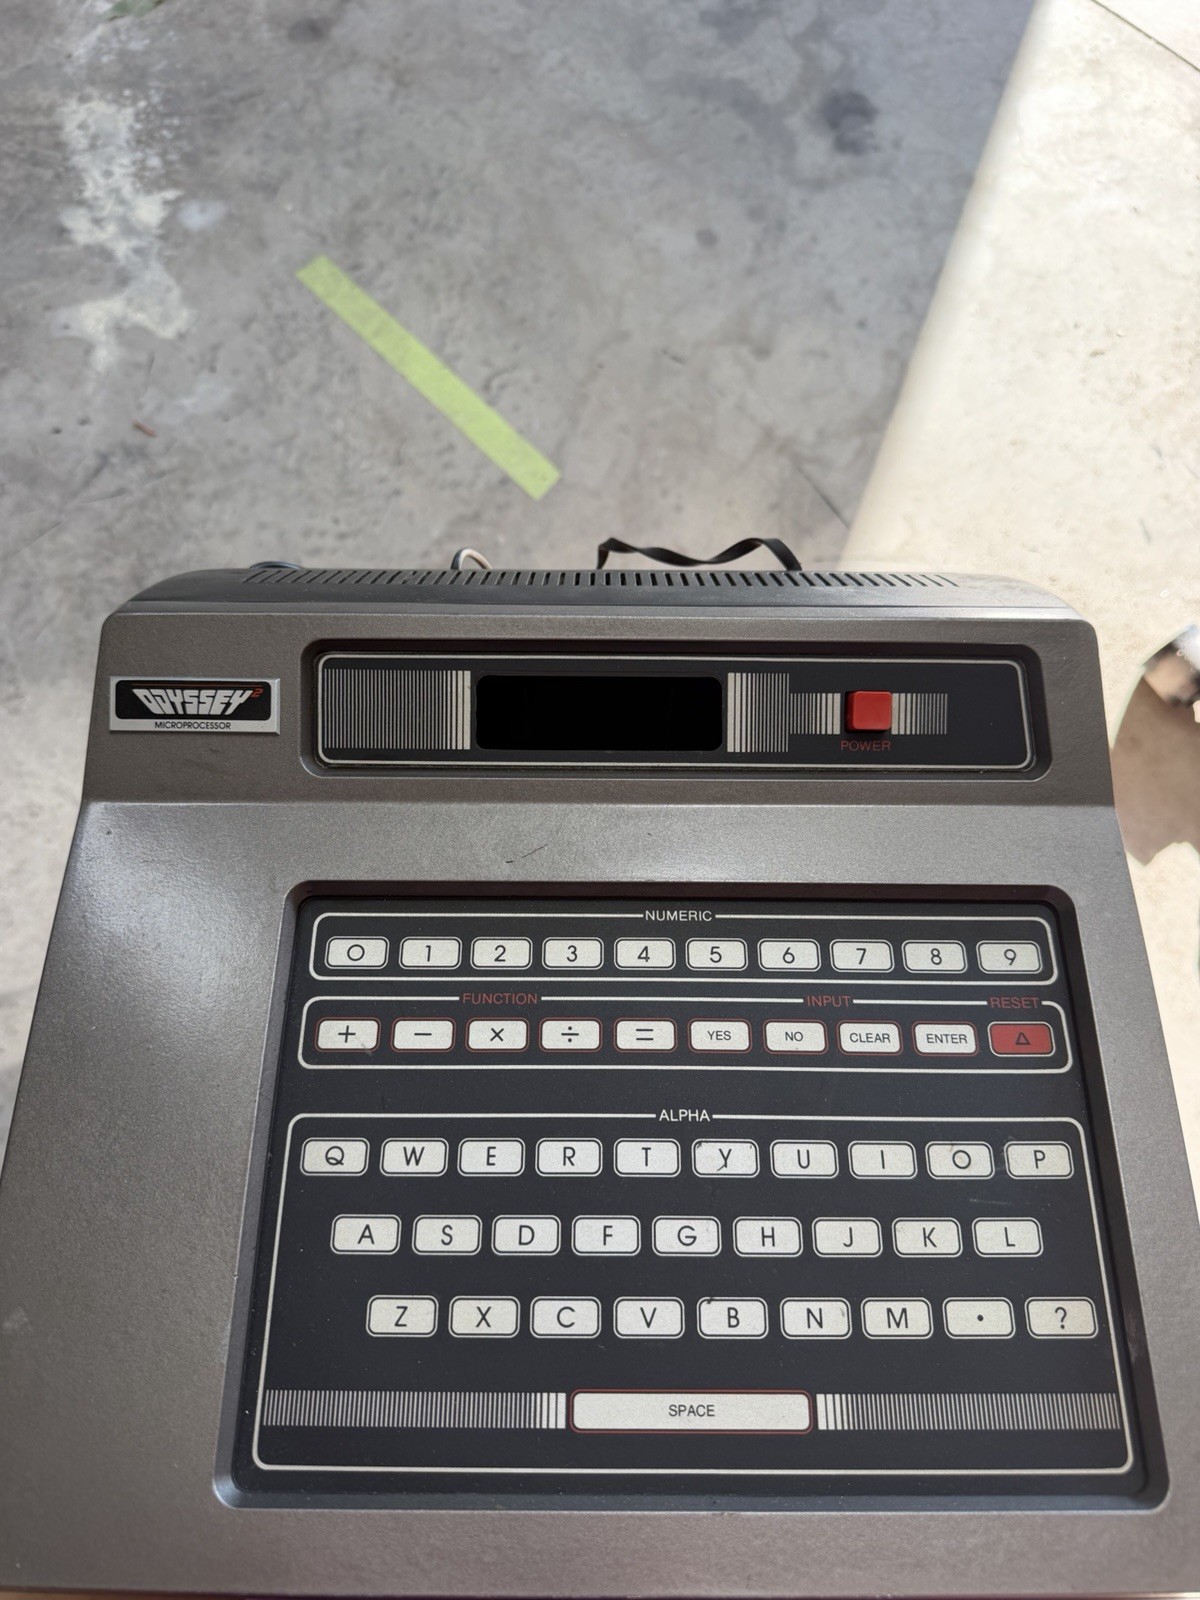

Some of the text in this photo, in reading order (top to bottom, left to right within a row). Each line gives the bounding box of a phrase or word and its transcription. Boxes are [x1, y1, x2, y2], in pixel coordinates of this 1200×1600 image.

[154, 720, 231, 730] MICROPROCESSOR
[840, 740, 892, 751] POWER
[645, 910, 713, 922] NUMERIC
[425, 944, 432, 963] 1
[493, 944, 507, 963] 2
[566, 944, 578, 963] 3
[637, 945, 651, 963] 4
[709, 945, 723, 964] 5
[782, 946, 796, 965] 6
[855, 947, 867, 965] 7
[930, 947, 943, 966] 8
[1003, 948, 1017, 966] 9
[462, 992, 537, 1004] FUNCTION
[806, 995, 849, 1007] INPUT
[989, 997, 1037, 1008] RESET
[337, 1025, 357, 1044] +
[560, 1026, 580, 1043] ÷
[635, 1028, 654, 1041] =
[707, 1030, 732, 1041] YES
[784, 1031, 804, 1042] NO
[849, 1032, 891, 1044] CLEAR
[926, 1033, 968, 1044] ENTER
[658, 1108, 711, 1122] ALPHA
[324, 1145, 345, 1166] Q
[402, 1146, 425, 1167] W
[486, 1146, 497, 1167] E
[562, 1146, 576, 1167] R
[641, 1146, 652, 1167] T
[718, 1148, 732, 1168] Y
[796, 1149, 811, 1170] U
[951, 1149, 972, 1170] O
[1033, 1149, 1046, 1170] P
[357, 1223, 1016, 1248] A S D F G H J K L
[394, 1305, 409, 1328] Z
[475, 1306, 492, 1328] X
[556, 1306, 576, 1329] C
[639, 1306, 657, 1329] V
[727, 1306, 740, 1329] B
[806, 1307, 824, 1329] N
[886, 1307, 909, 1329] M
[1054, 1306, 1068, 1330] ?
[668, 1404, 716, 1418] SPACE
